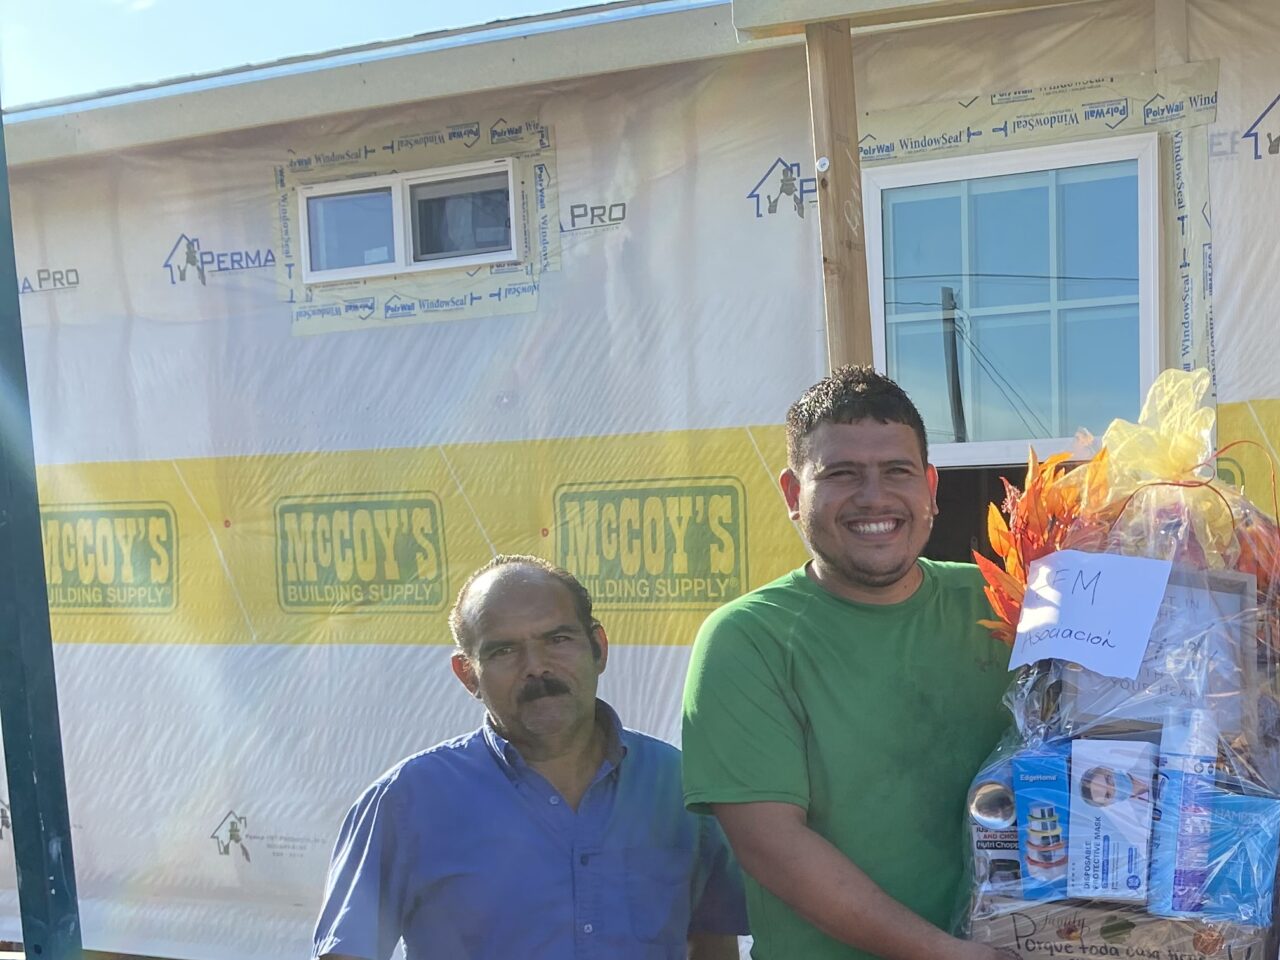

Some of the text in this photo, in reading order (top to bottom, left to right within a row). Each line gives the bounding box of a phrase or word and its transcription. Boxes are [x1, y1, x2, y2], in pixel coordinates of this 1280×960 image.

[1013, 112, 1080, 133] WindowSeal
[899, 131, 962, 149] WindowSeal
[570, 202, 626, 228] PRO
[200, 249, 276, 271] PERMA
[37, 268, 80, 288] PRO
[286, 583, 433, 602] BUILDING SUPPLY
